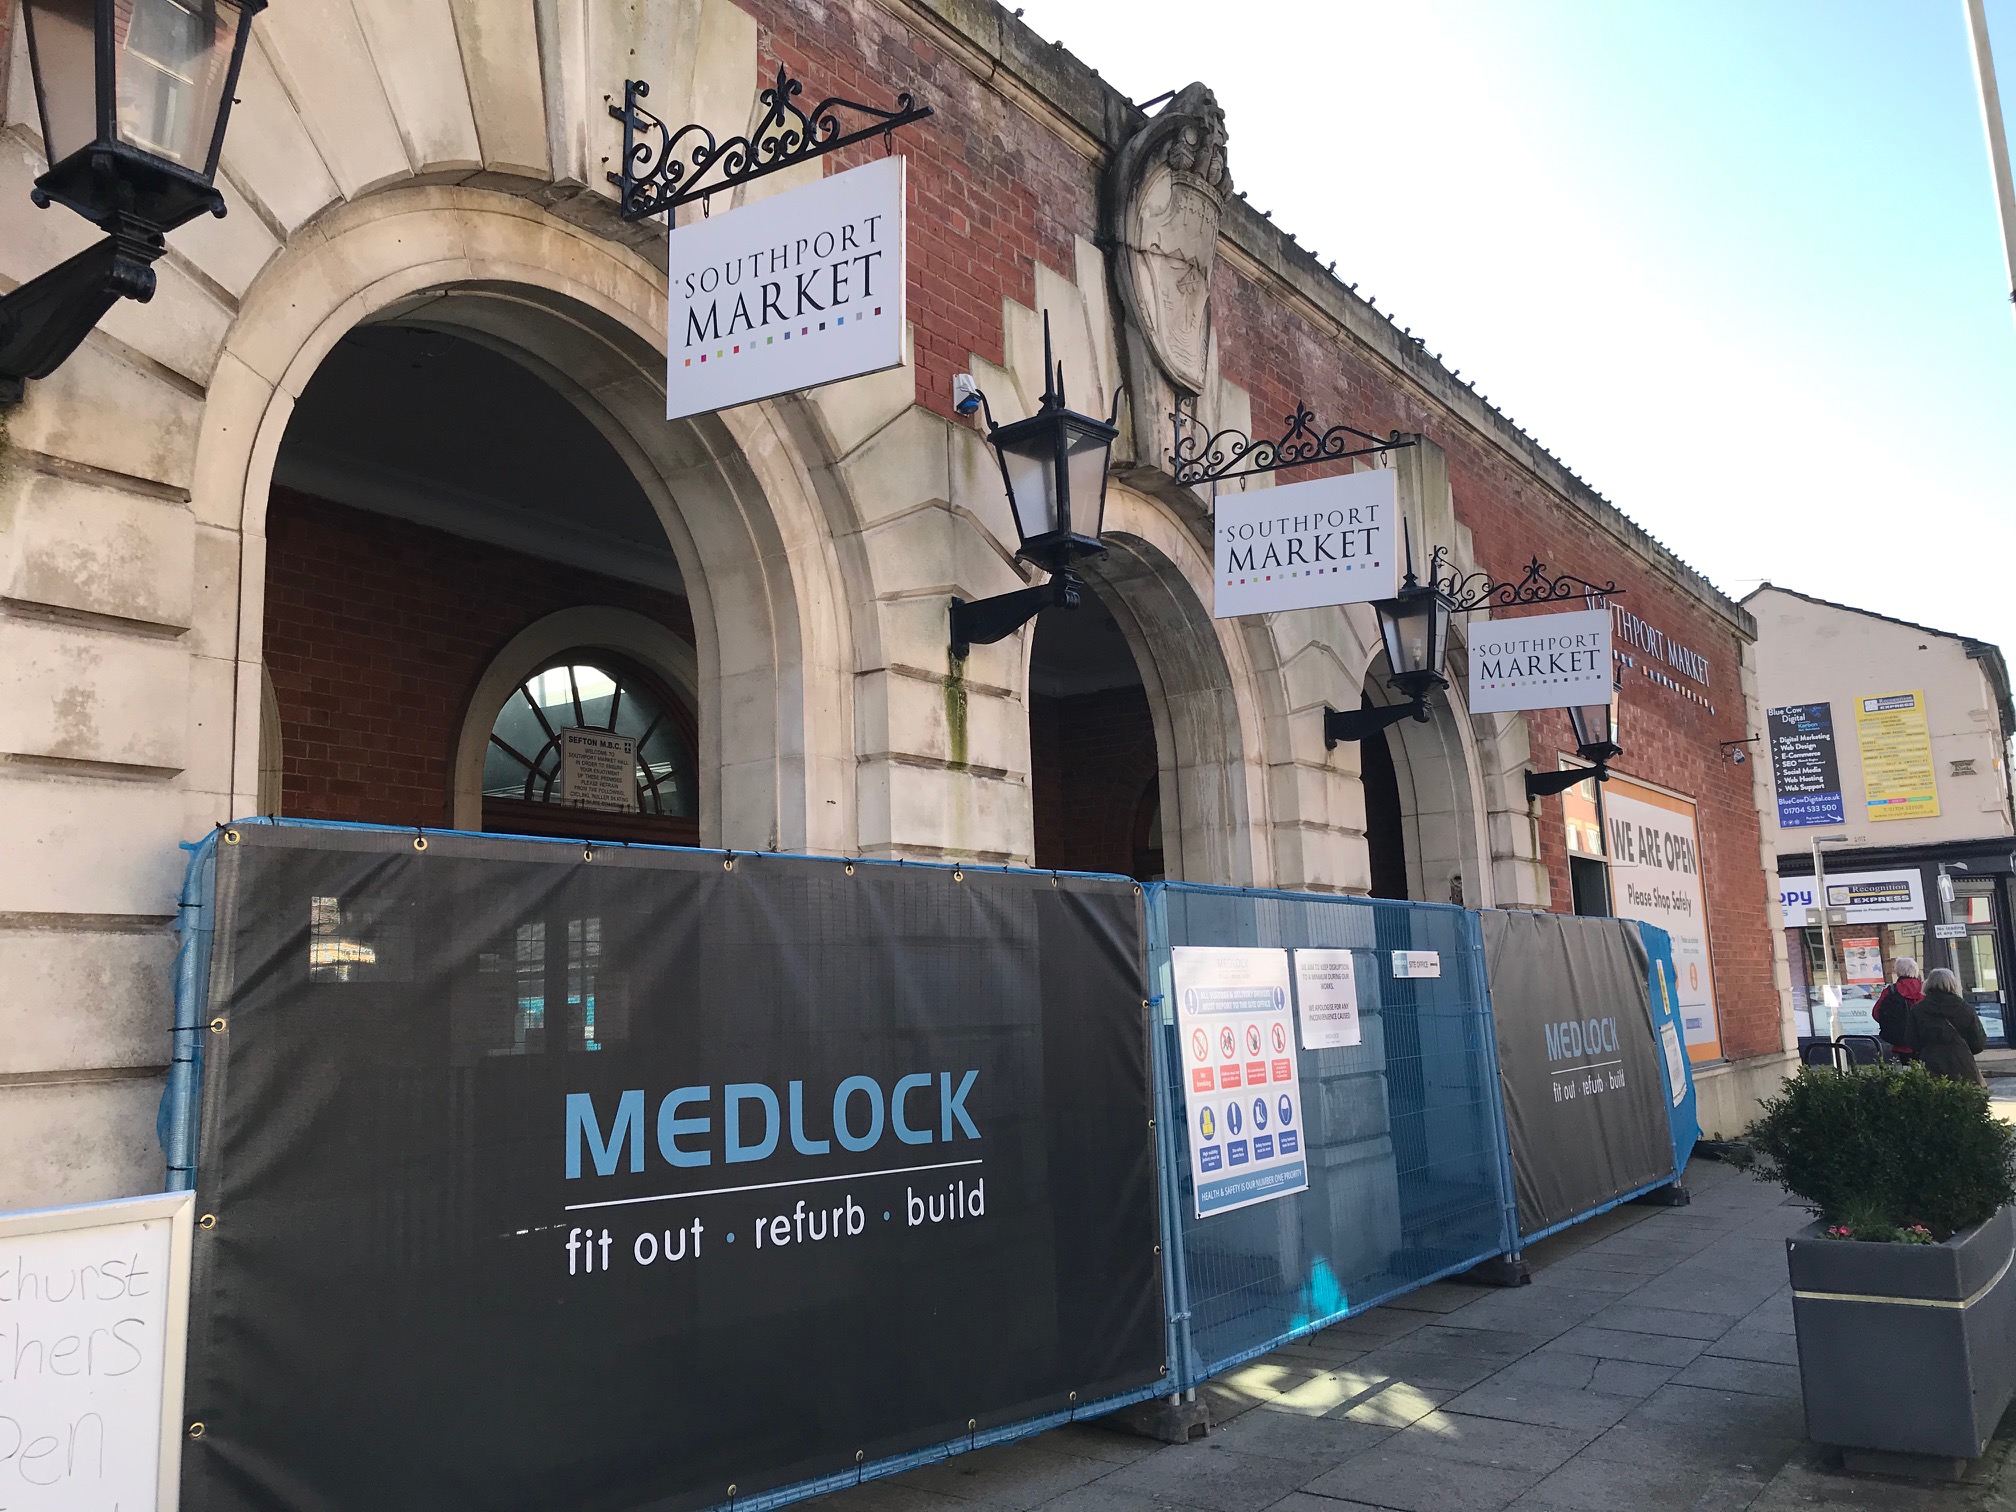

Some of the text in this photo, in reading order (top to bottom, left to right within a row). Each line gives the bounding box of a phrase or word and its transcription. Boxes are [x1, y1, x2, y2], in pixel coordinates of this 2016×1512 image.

[685, 215, 882, 298] SOUTHPORT
[685, 250, 882, 347] MARKET
[1227, 504, 1379, 543] SOUTHPORT
[1227, 527, 1380, 574] MARKET
[1479, 633, 1600, 657] SOUTHPORT
[1667, 637, 1710, 687] MARKET
[1481, 650, 1600, 680] MARKET
[1782, 713, 1805, 724] Digital
[568, 736, 621, 750] SEFTON M.B.C.
[1779, 733, 1830, 744] Digital Marketing
[1778, 794, 1840, 805] BlueCowDigital.co.uk
[1800, 783, 1825, 792] Support
[1610, 817, 1697, 875] WE ARE OPEN
[1627, 883, 1692, 917] Please Shop Safely
[1852, 883, 1907, 893] Recognition
[1854, 894, 1910, 904] EXPRESS
[1544, 1017, 1620, 1061] MEDLOCK
[1553, 1068, 1625, 1102] fit out refurb build
[565, 1069, 982, 1180] MEDLOCK
[1202, 1190, 1220, 1202] HEALTH
[1225, 1185, 1241, 1195] SAFETY
[1246, 1181, 1255, 1190] OUR
[1256, 1176, 1274, 1187] NUMBER
[1274, 1174, 1284, 1182] ONE
[1284, 1169, 1302, 1180] PRIORITY
[565, 1177, 985, 1276] fit out refurb build
[0, 1318, 144, 1379] hers
